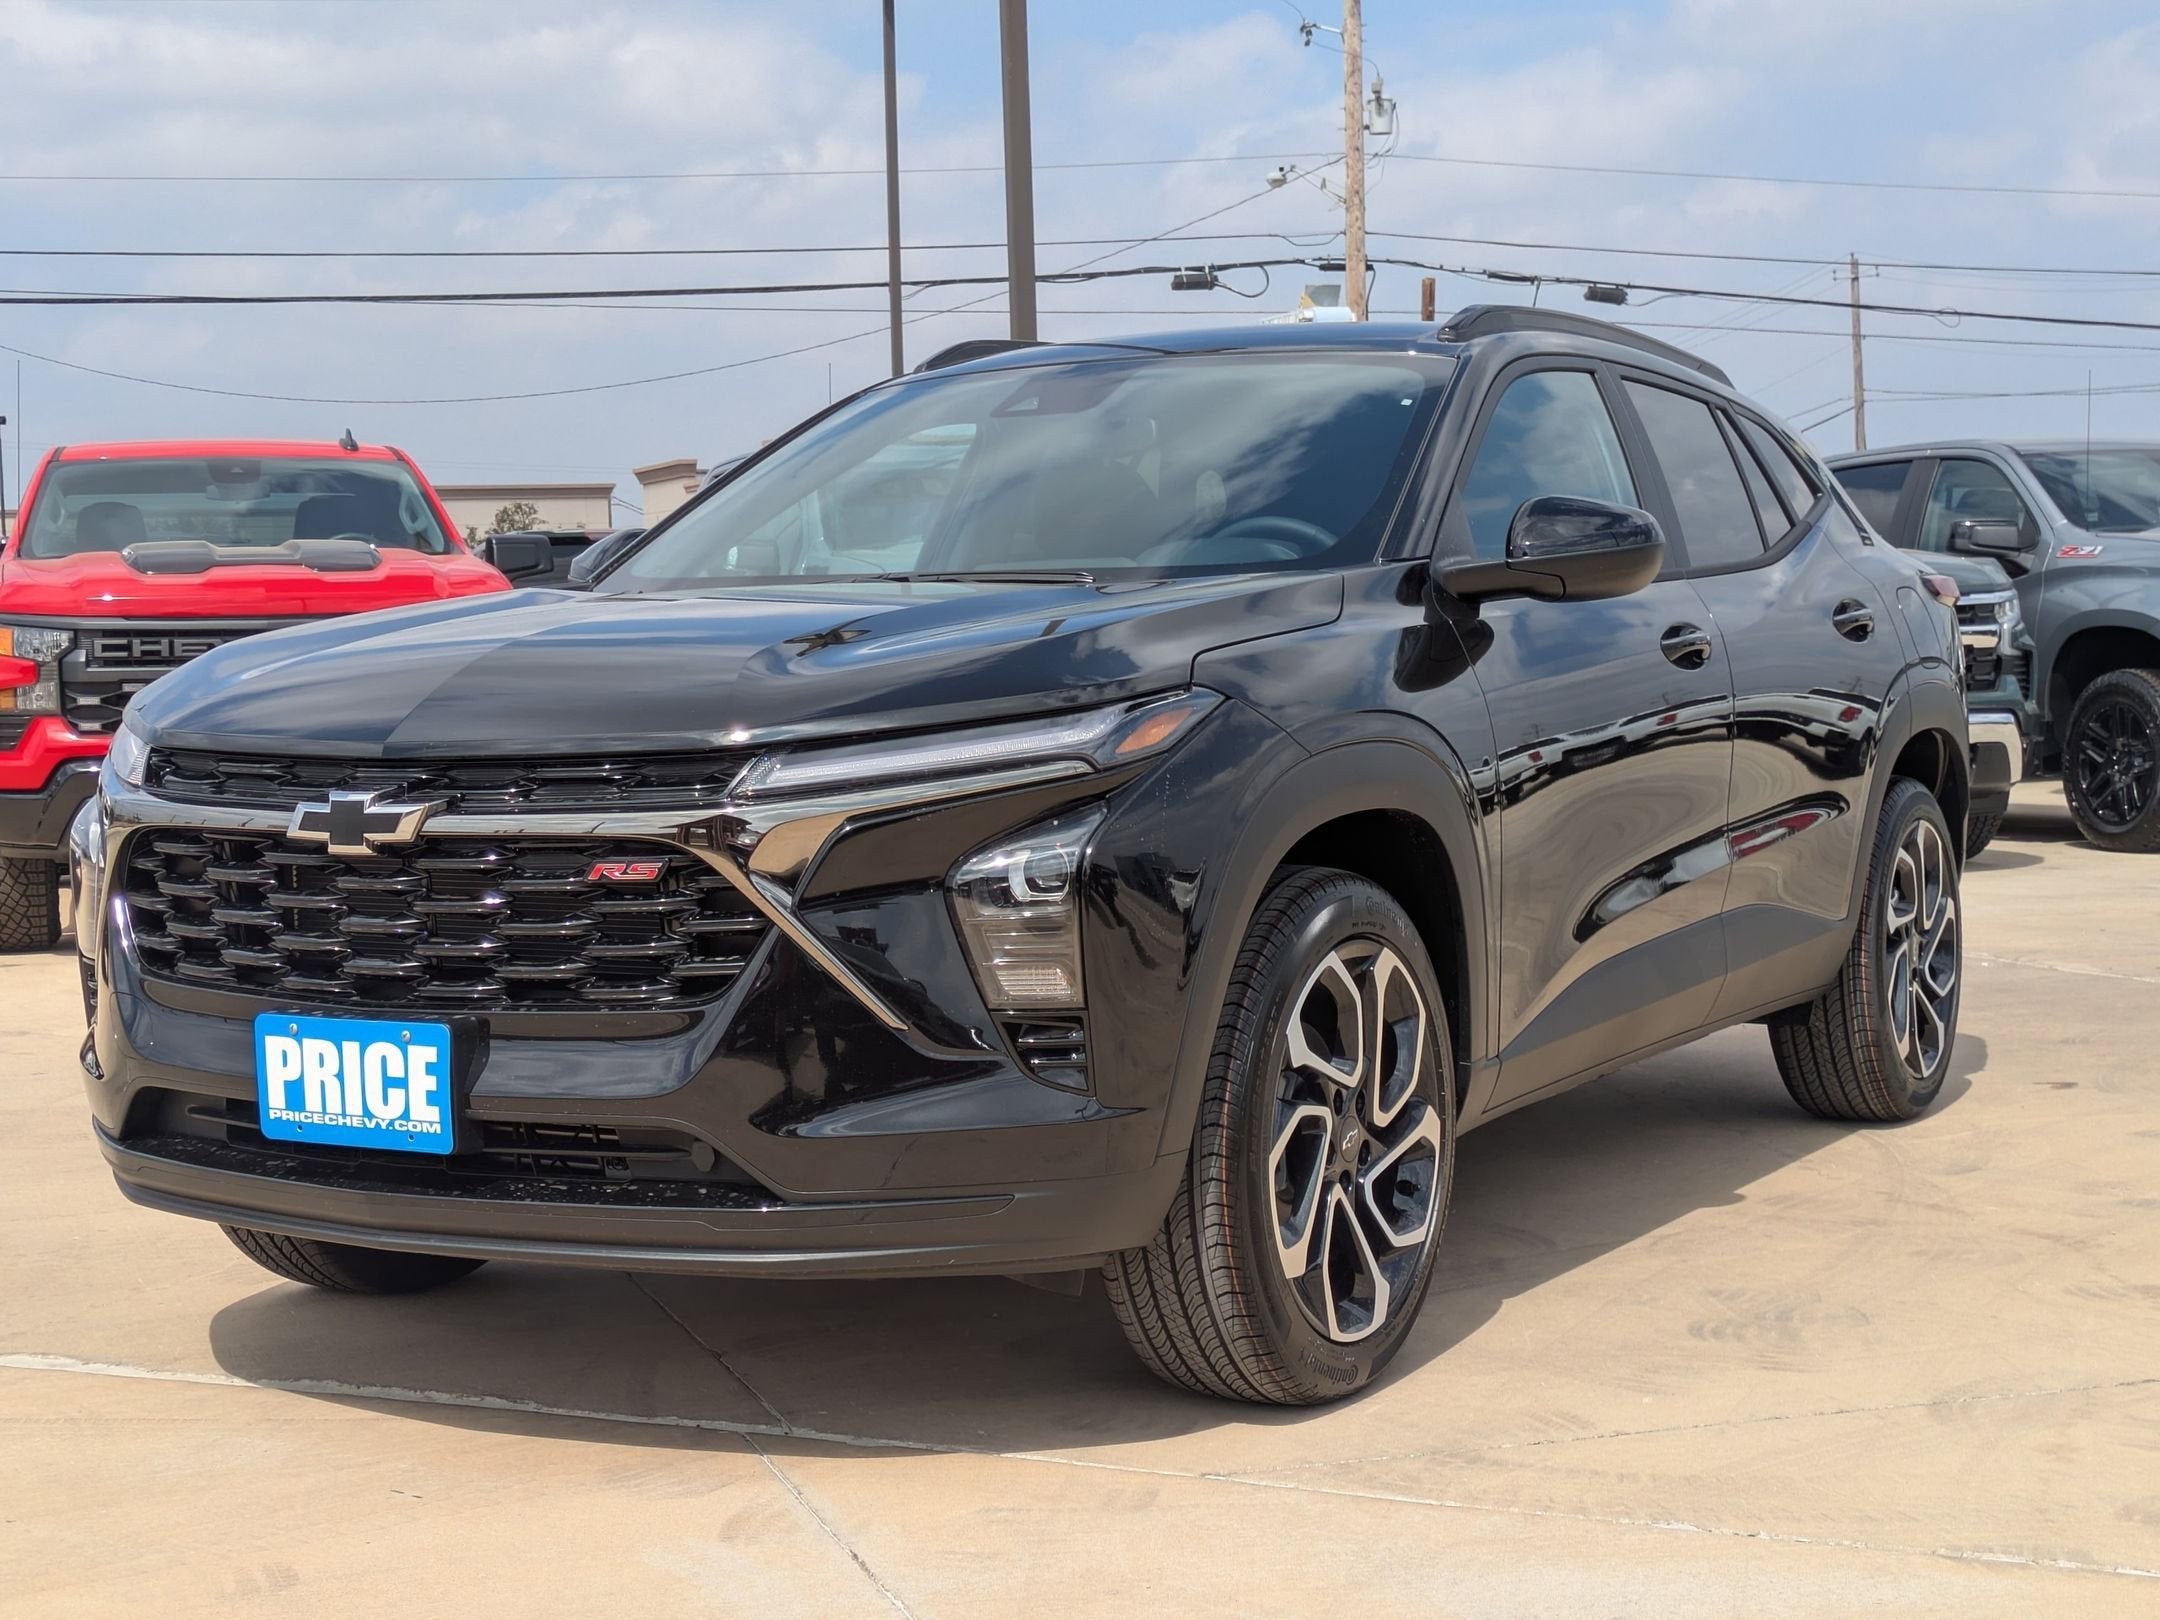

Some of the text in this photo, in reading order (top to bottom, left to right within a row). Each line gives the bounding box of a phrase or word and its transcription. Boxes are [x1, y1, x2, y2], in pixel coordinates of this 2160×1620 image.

[2056, 545, 2103, 558] Z71
[588, 862, 663, 880] RS
[264, 1035, 441, 1122] PRICE
[269, 1109, 441, 1134] PRICECHEVY.COM
[1305, 1353, 1359, 1385] Continental
